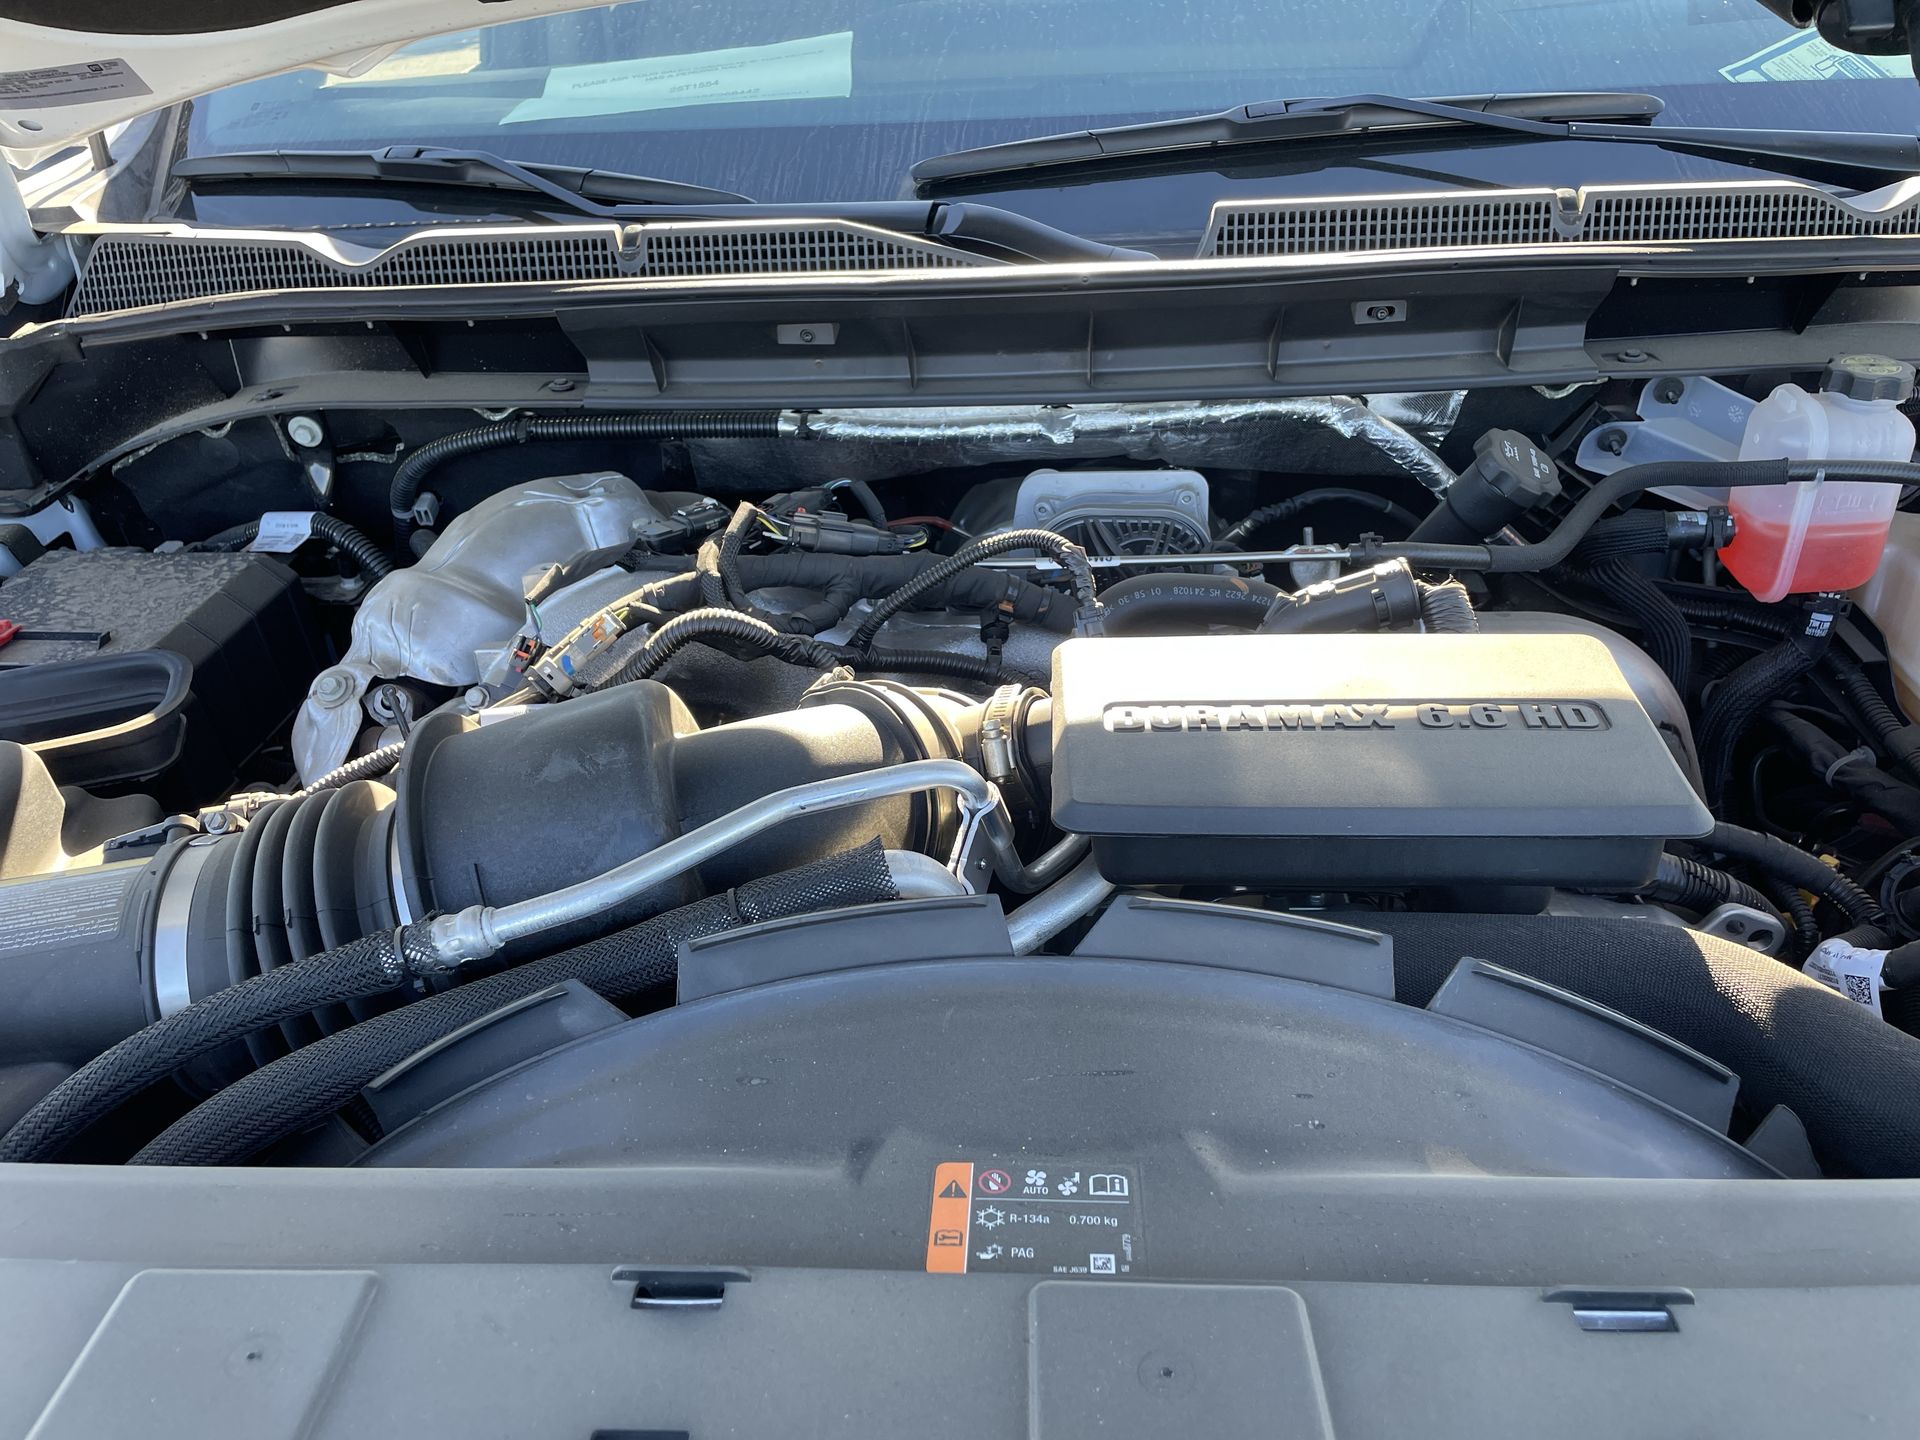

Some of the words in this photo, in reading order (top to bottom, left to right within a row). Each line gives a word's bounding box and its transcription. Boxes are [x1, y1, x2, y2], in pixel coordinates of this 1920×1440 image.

[1173, 587, 1207, 596] 241028
[1111, 703, 1395, 731] DURAMAX
[1417, 703, 1508, 729] 6.6
[1518, 703, 1601, 729] HD
[1023, 1186, 1049, 1195] AUTO
[1009, 1213, 1050, 1224] R-134a
[1069, 1215, 1101, 1225] 0.700
[1104, 1215, 1118, 1226] kg
[1011, 1247, 1034, 1258] PAG
